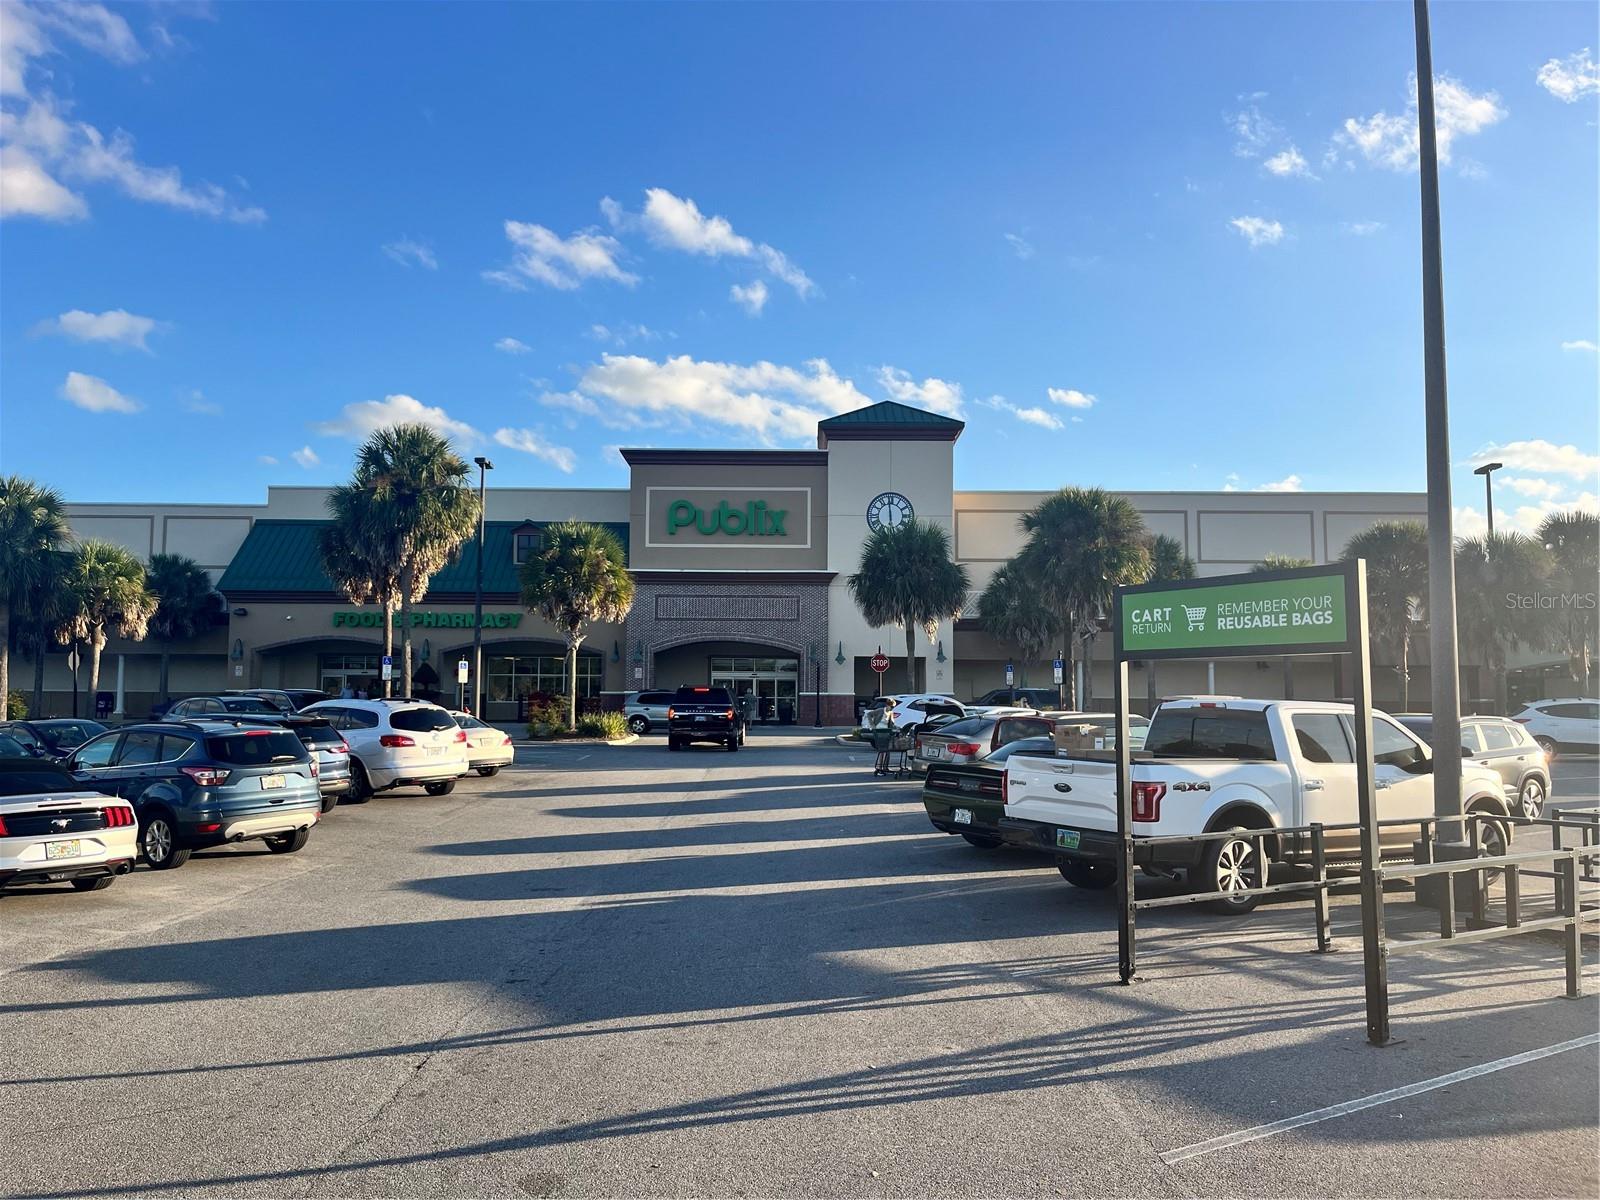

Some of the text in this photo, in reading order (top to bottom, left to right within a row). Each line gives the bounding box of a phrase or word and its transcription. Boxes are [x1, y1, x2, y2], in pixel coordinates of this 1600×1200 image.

[667, 499, 788, 536] Publix
[1217, 595, 1332, 616] REMEMBER YOUR
[1131, 607, 1172, 623] CART
[1217, 610, 1333, 630] REUSABLE BAGS
[1132, 622, 1172, 635] RETURN
[872, 659, 888, 667] STOP
